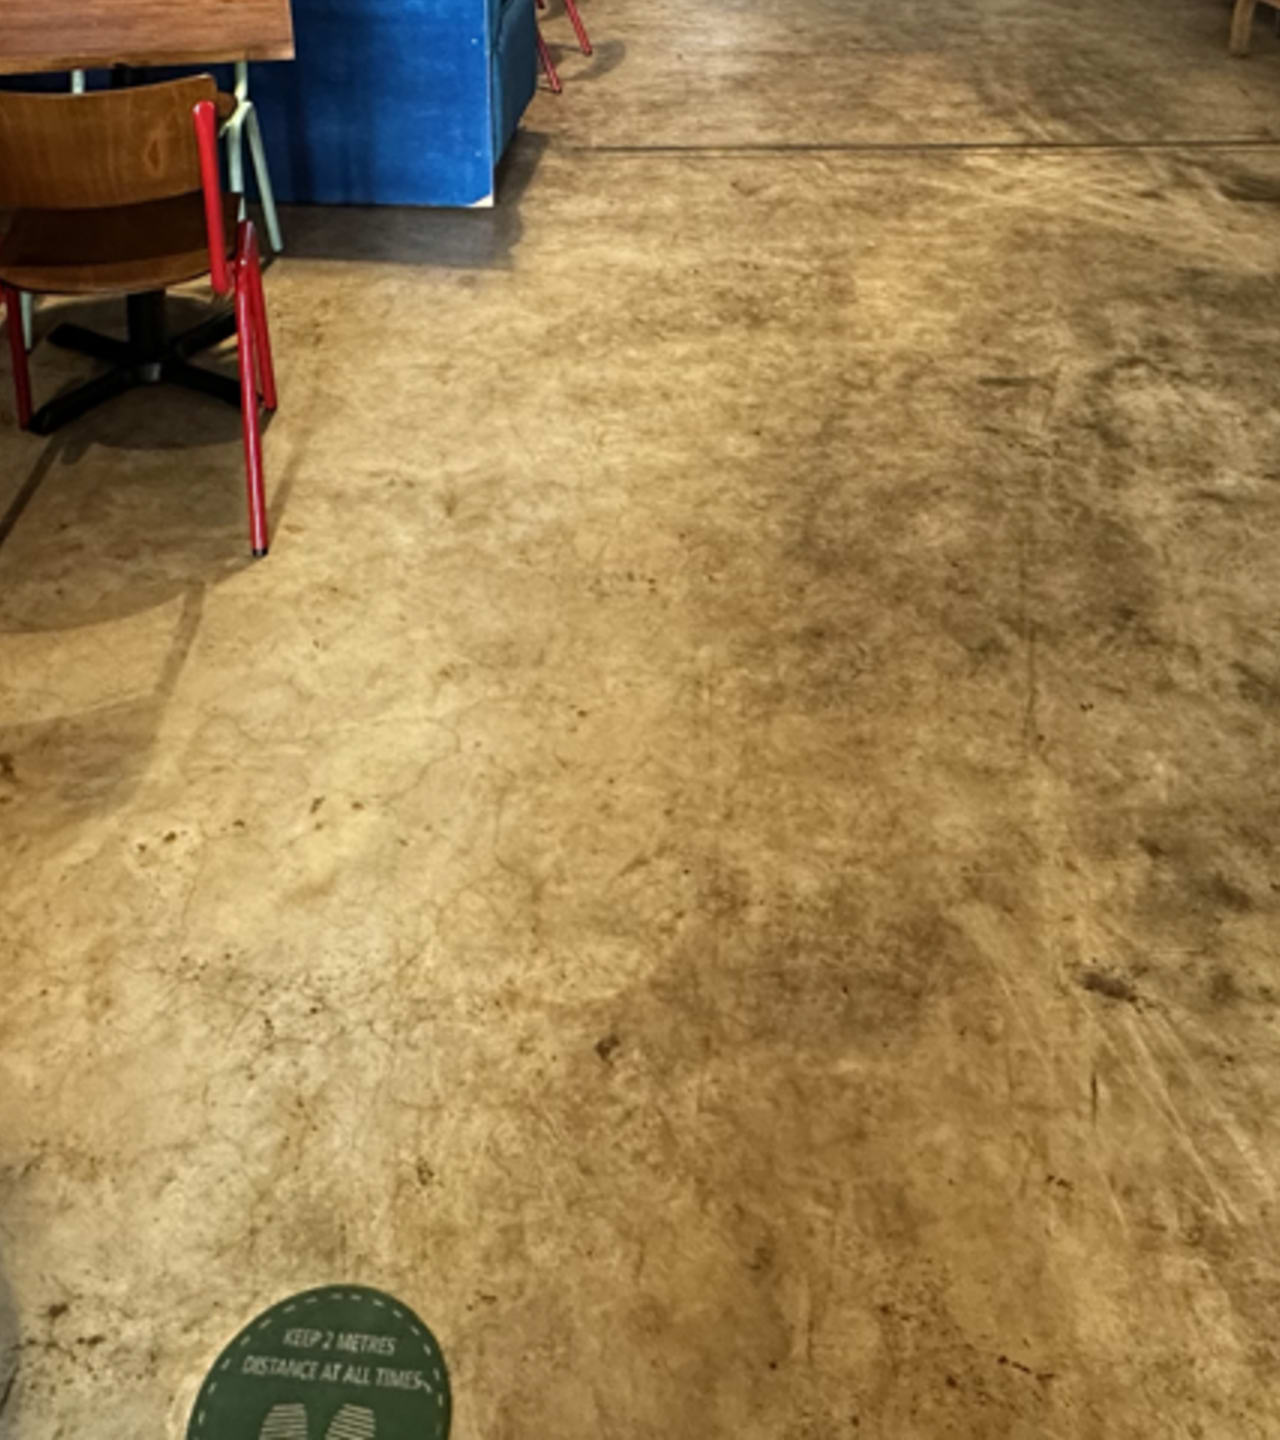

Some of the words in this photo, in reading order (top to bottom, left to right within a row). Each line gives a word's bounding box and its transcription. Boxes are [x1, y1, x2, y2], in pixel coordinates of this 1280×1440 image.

[283, 1328, 320, 1348] KEEP
[322, 1331, 334, 1350] 2
[335, 1332, 398, 1356] METRES
[242, 1355, 318, 1381] DISTANCE
[319, 1363, 343, 1381] AT
[343, 1366, 371, 1386] ALL
